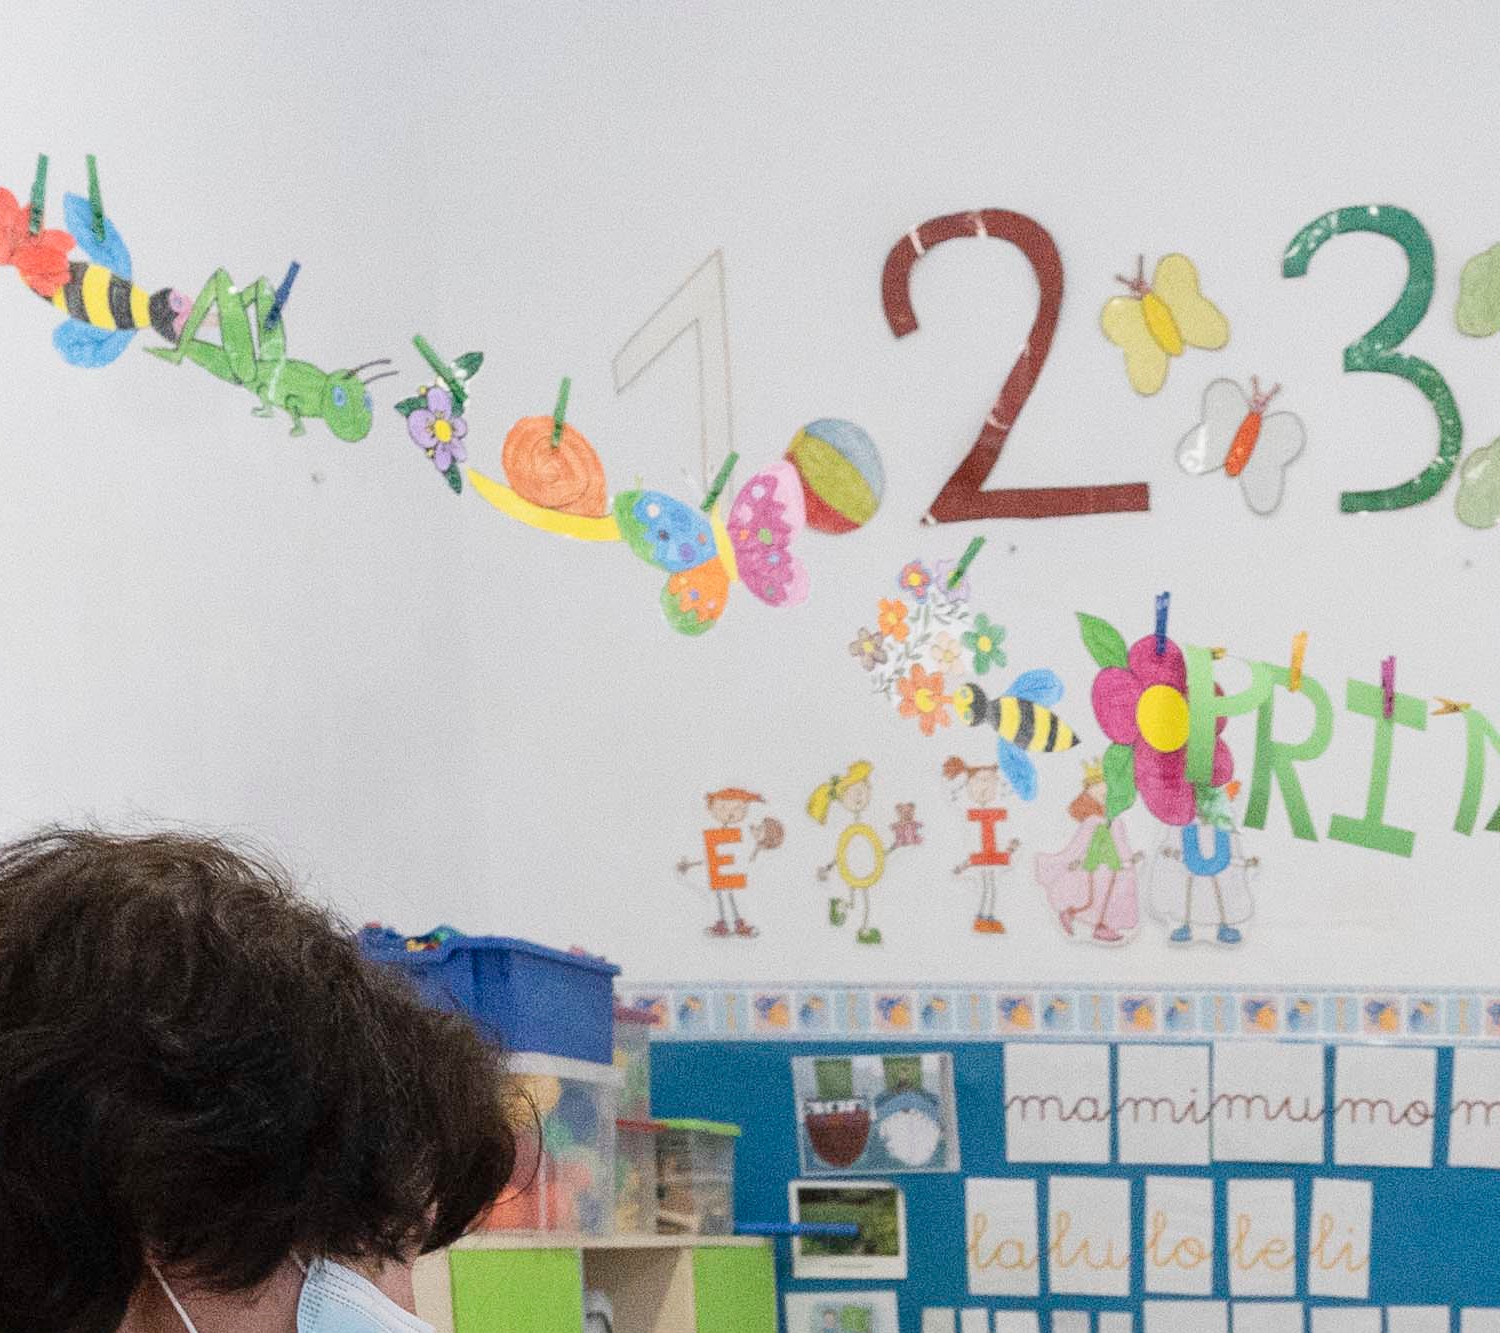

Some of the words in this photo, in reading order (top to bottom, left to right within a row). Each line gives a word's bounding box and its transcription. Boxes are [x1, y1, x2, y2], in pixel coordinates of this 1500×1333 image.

[882, 208, 1150, 525] 2
[1282, 204, 1464, 513] 3
[704, 828, 747, 890] E
[967, 809, 1010, 866] I
[1005, 1094, 1111, 1122] ma
[1118, 1089, 1211, 1124] mi
[1211, 1093, 1325, 1123] mu
[1336, 1095, 1435, 1127] mo
[968, 1213, 1038, 1270] la
[1049, 1210, 1130, 1270] lu
[1145, 1210, 1212, 1270] lo
[1228, 1213, 1296, 1270] le
[1308, 1212, 1367, 1274] li
